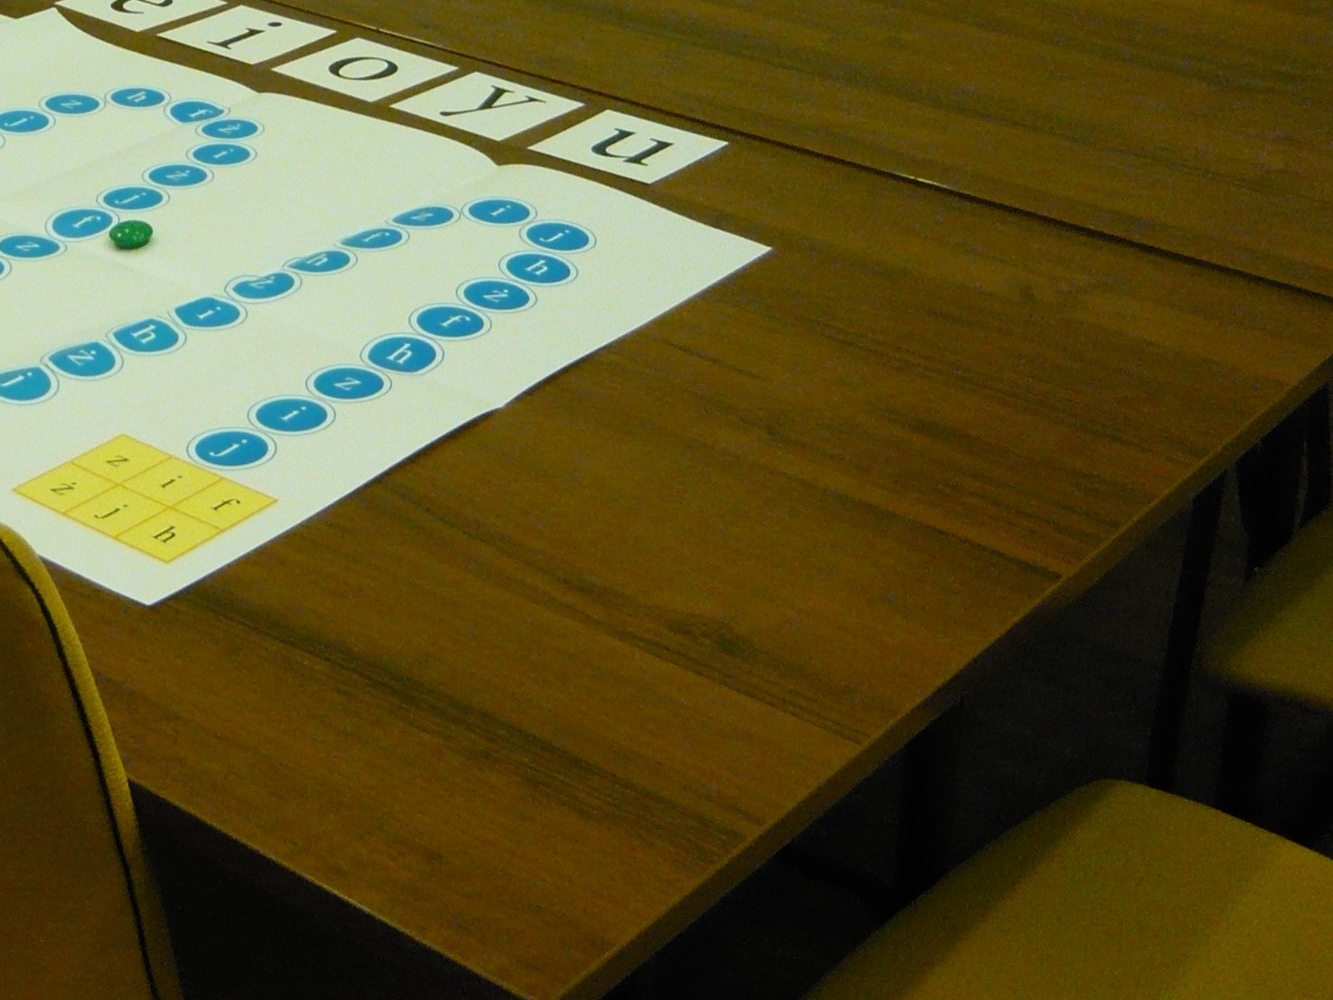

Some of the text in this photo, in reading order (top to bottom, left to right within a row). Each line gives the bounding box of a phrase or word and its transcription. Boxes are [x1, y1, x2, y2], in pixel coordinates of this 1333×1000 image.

[208, 21, 283, 50] i
[328, 56, 399, 81] o
[439, 85, 547, 117] y
[590, 126, 675, 167] u
[50, 482, 177, 544] ż j h
[106, 455, 241, 512] z i f
